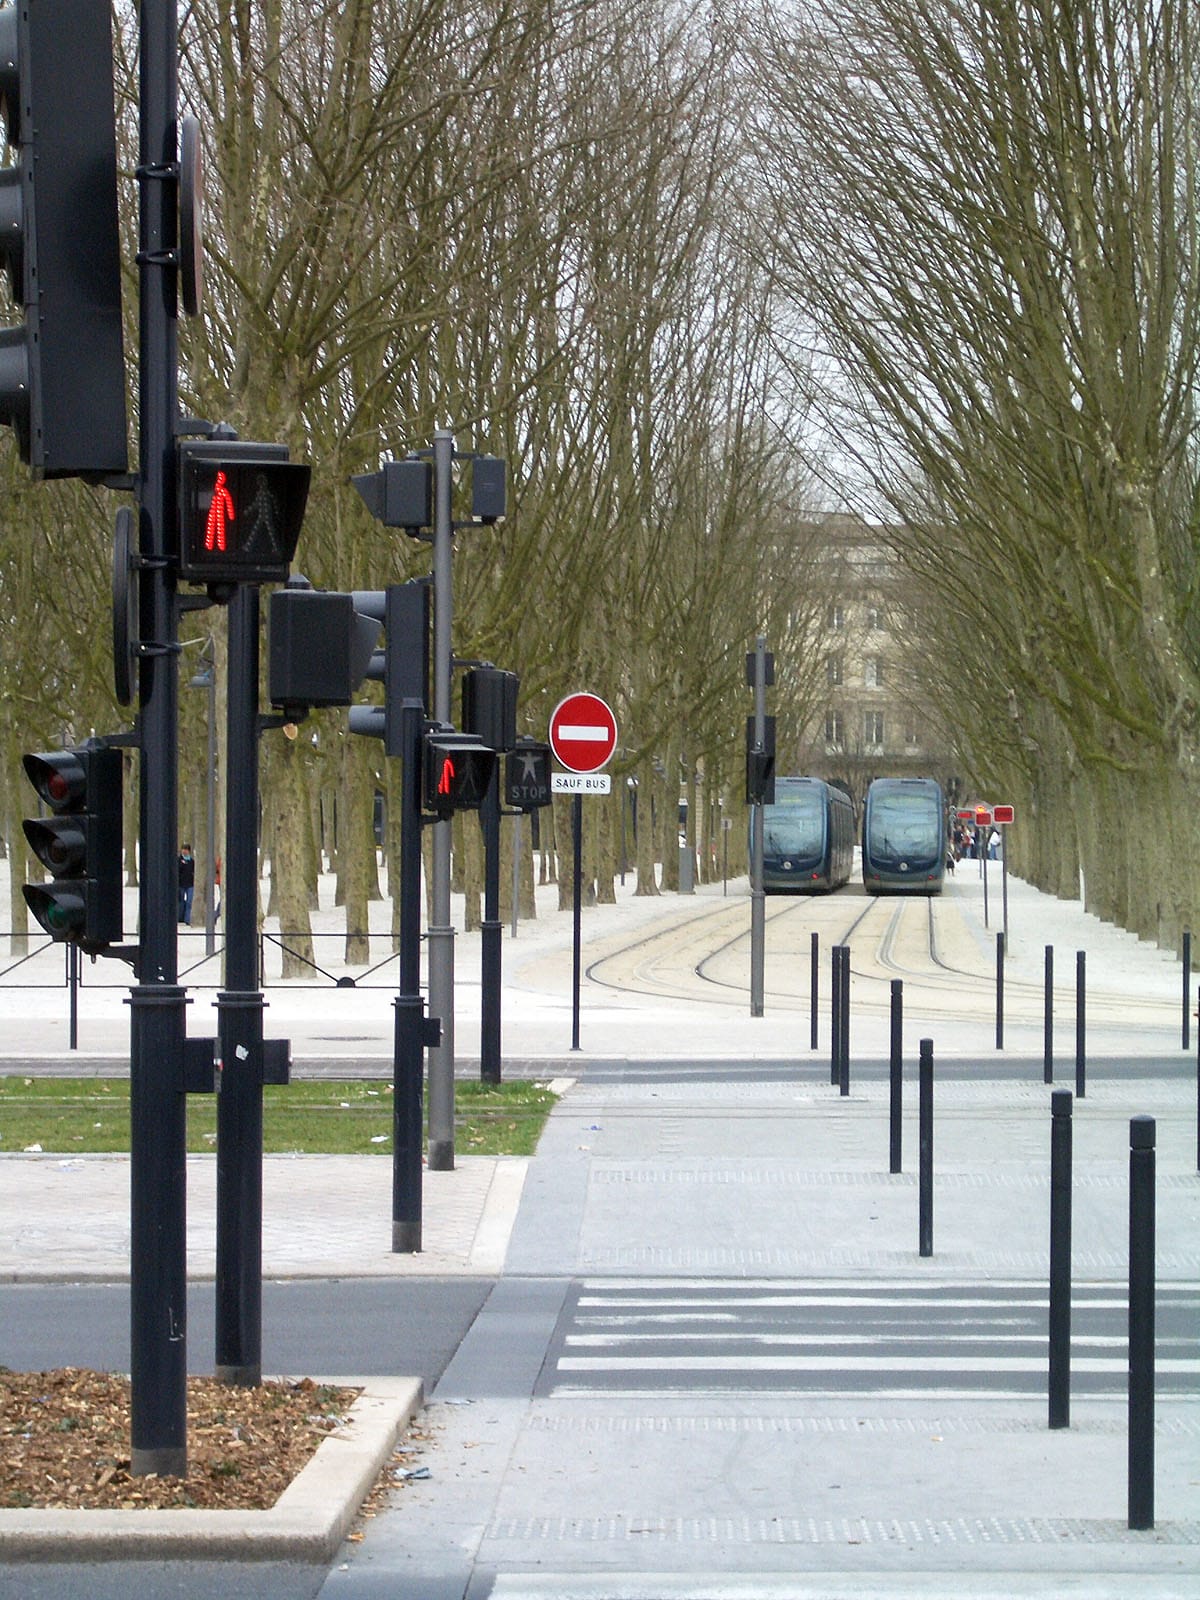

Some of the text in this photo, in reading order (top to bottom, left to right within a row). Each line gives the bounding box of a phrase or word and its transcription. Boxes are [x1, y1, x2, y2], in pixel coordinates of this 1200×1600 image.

[556, 778, 606, 789] SAUF BUS
[511, 786, 547, 799] STOP
